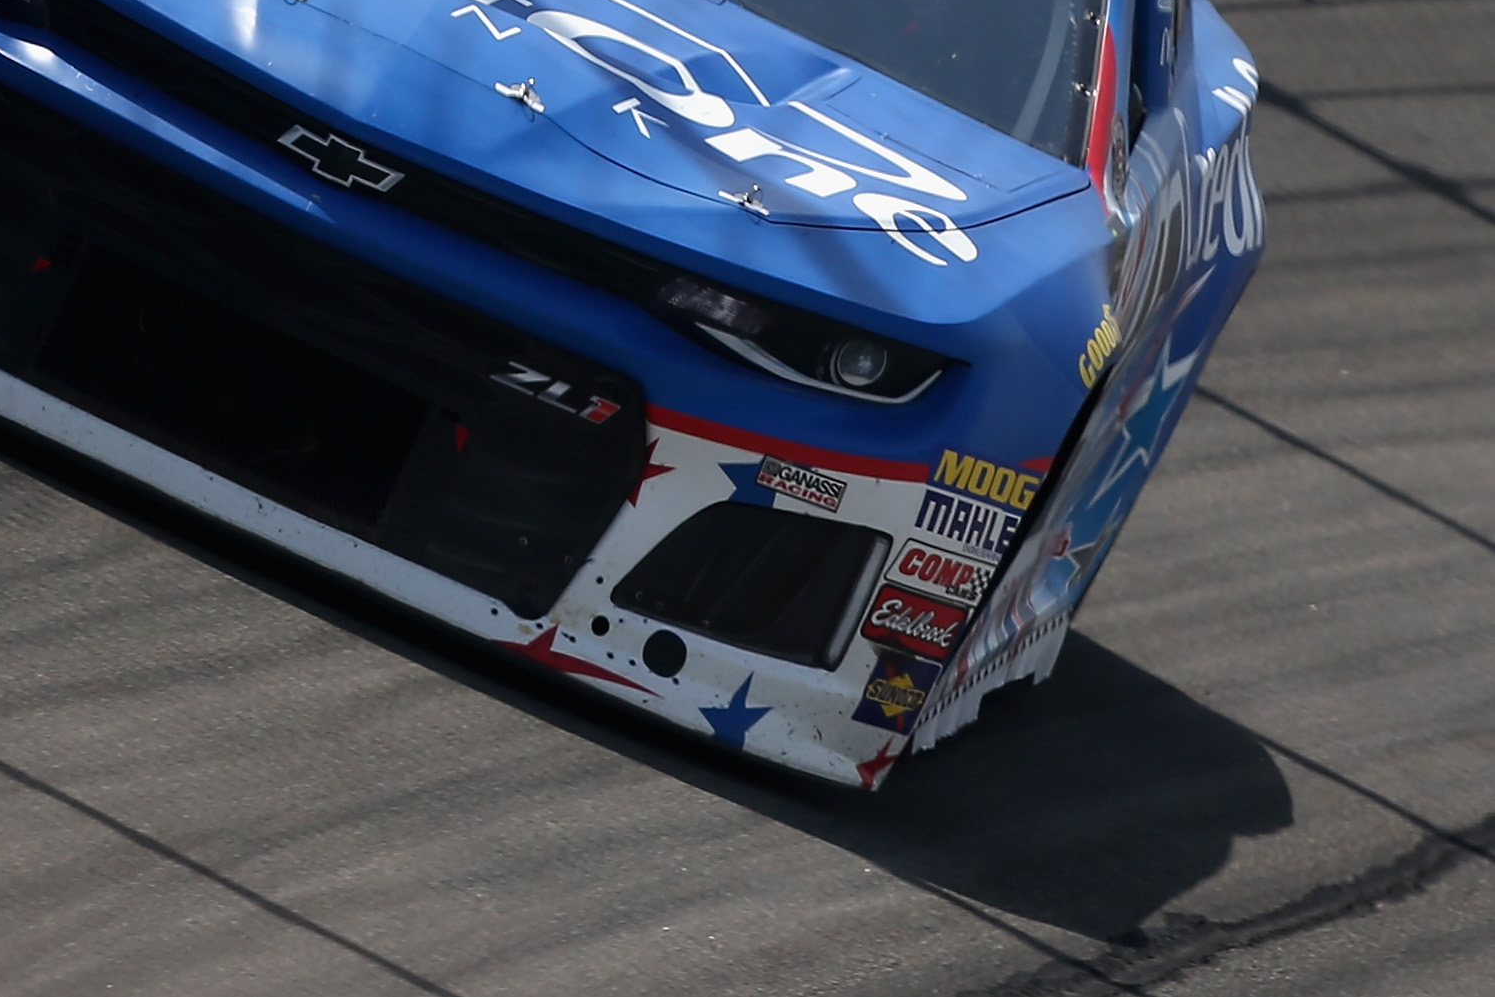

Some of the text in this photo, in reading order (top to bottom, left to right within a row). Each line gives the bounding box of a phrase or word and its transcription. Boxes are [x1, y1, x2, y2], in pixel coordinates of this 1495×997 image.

[528, 10, 979, 267] One
[490, 361, 621, 424] ZL1
[758, 474, 837, 508] RACING
[779, 466, 843, 498] GANASSI
[933, 449, 1040, 511] MOOG
[915, 489, 1018, 553] MAHLE
[899, 548, 976, 587] COMP
[871, 599, 958, 647] Edelbrock
